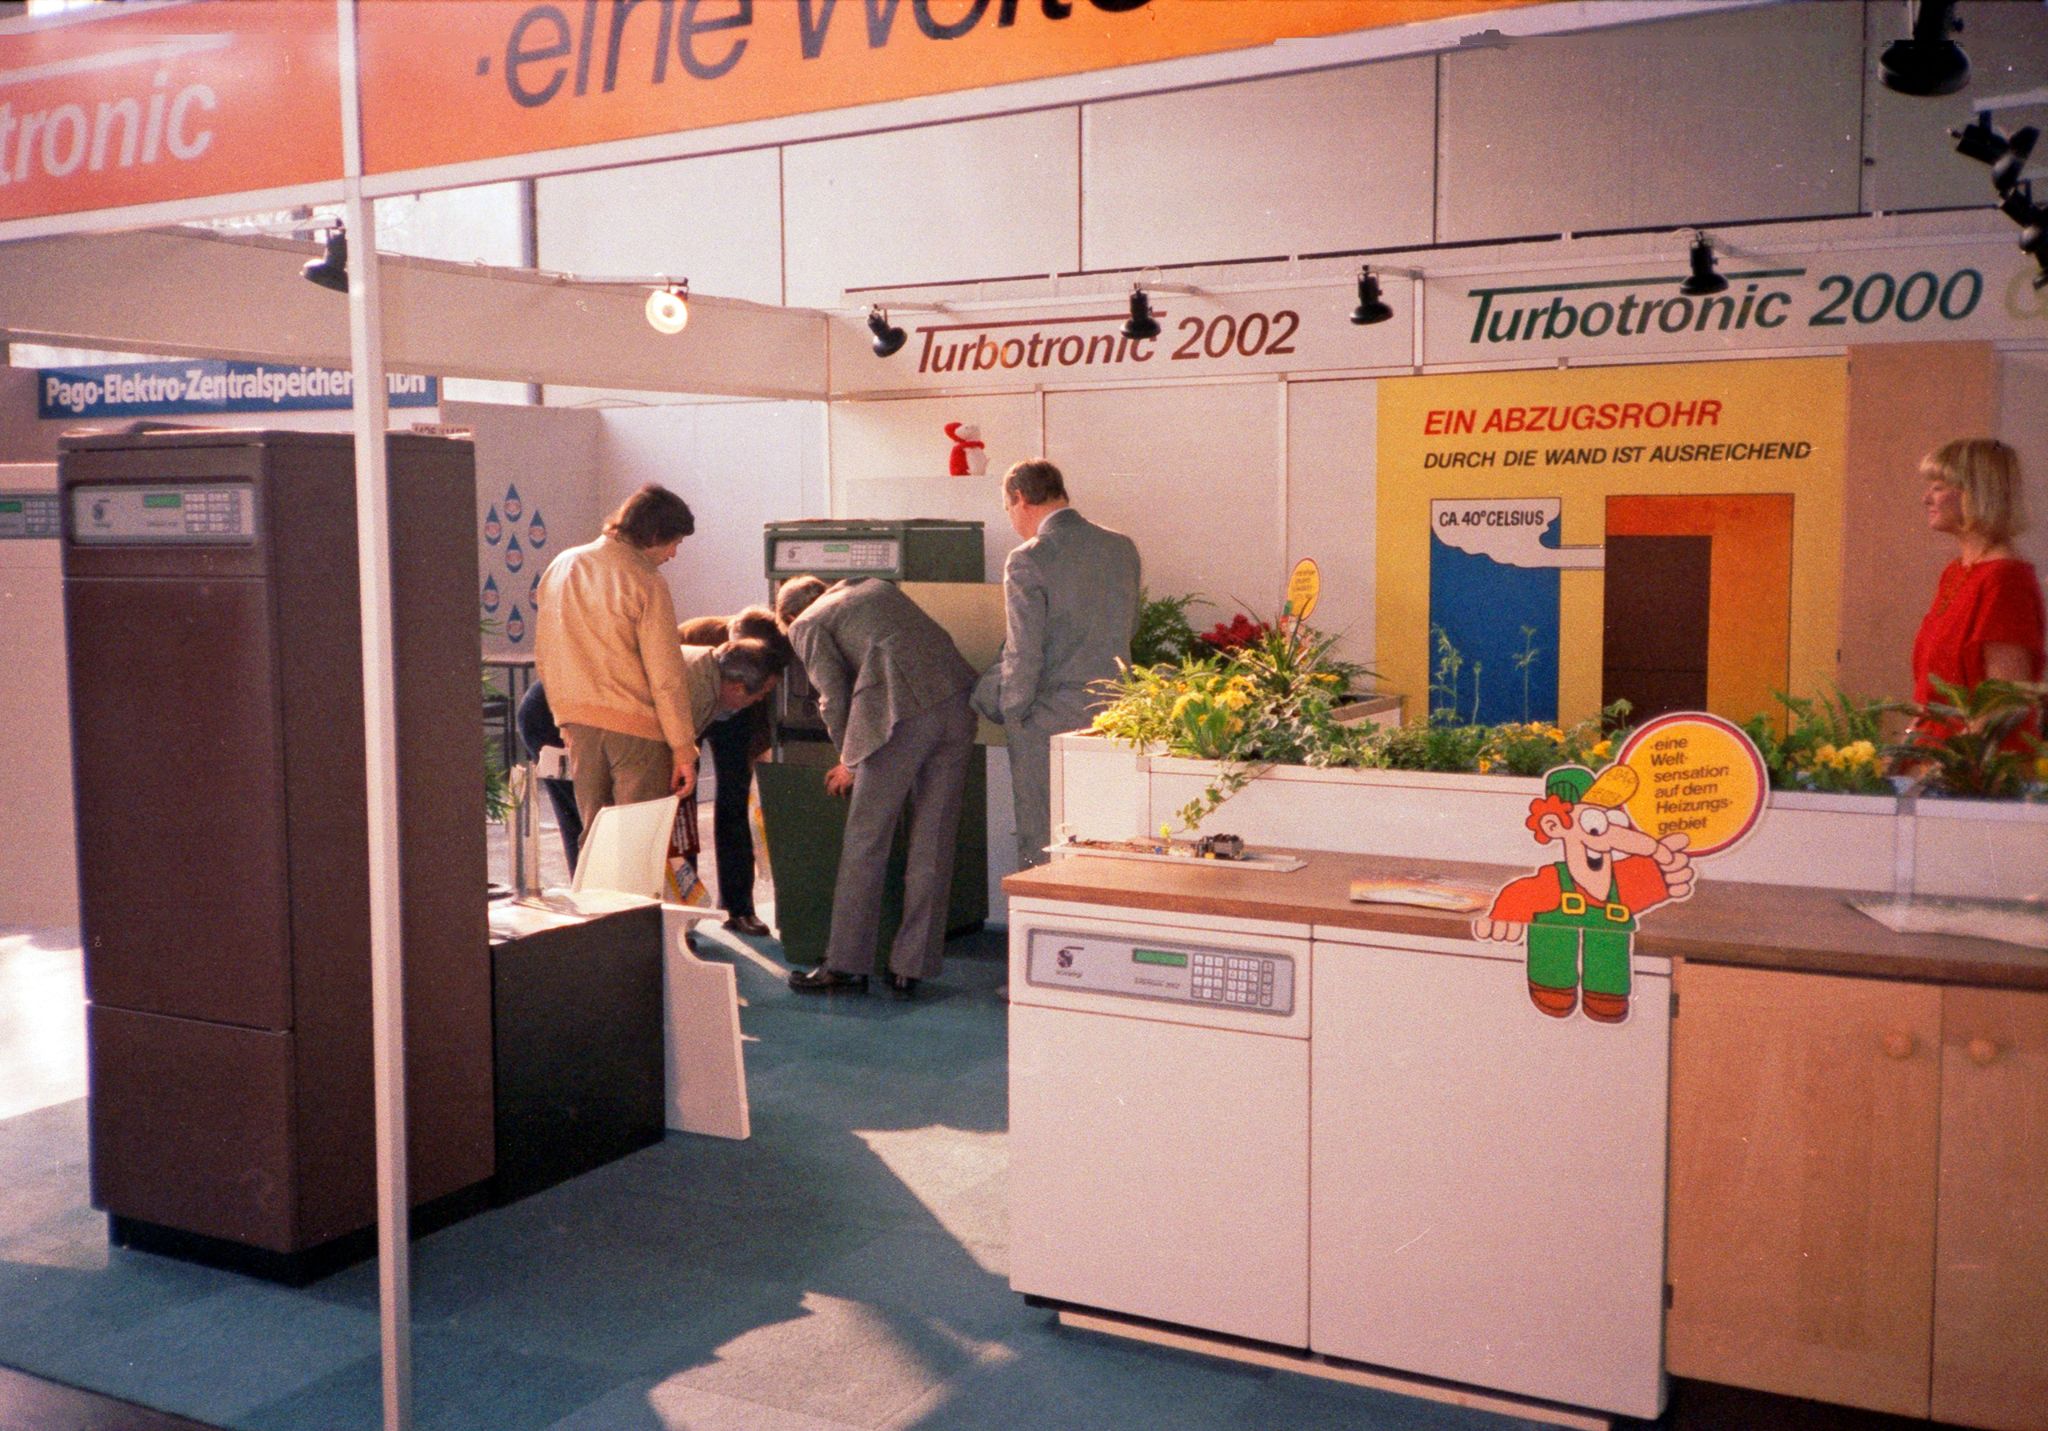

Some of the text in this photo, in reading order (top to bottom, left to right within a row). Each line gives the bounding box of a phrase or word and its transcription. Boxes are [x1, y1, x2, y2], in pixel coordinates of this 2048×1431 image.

[1467, 268, 1807, 344] Turbotronic
[1809, 267, 1984, 327] 2000
[915, 309, 1300, 373] Turbotronic 2002
[1424, 400, 1723, 435] EIN ABZUGSROHR
[1424, 441, 1812, 468] DURCH DIE WAND IST AUSREICHEND
[1653, 766, 1729, 783] sensation
[1655, 782, 1718, 799] auf dem
[1657, 817, 1708, 835] gebiet
